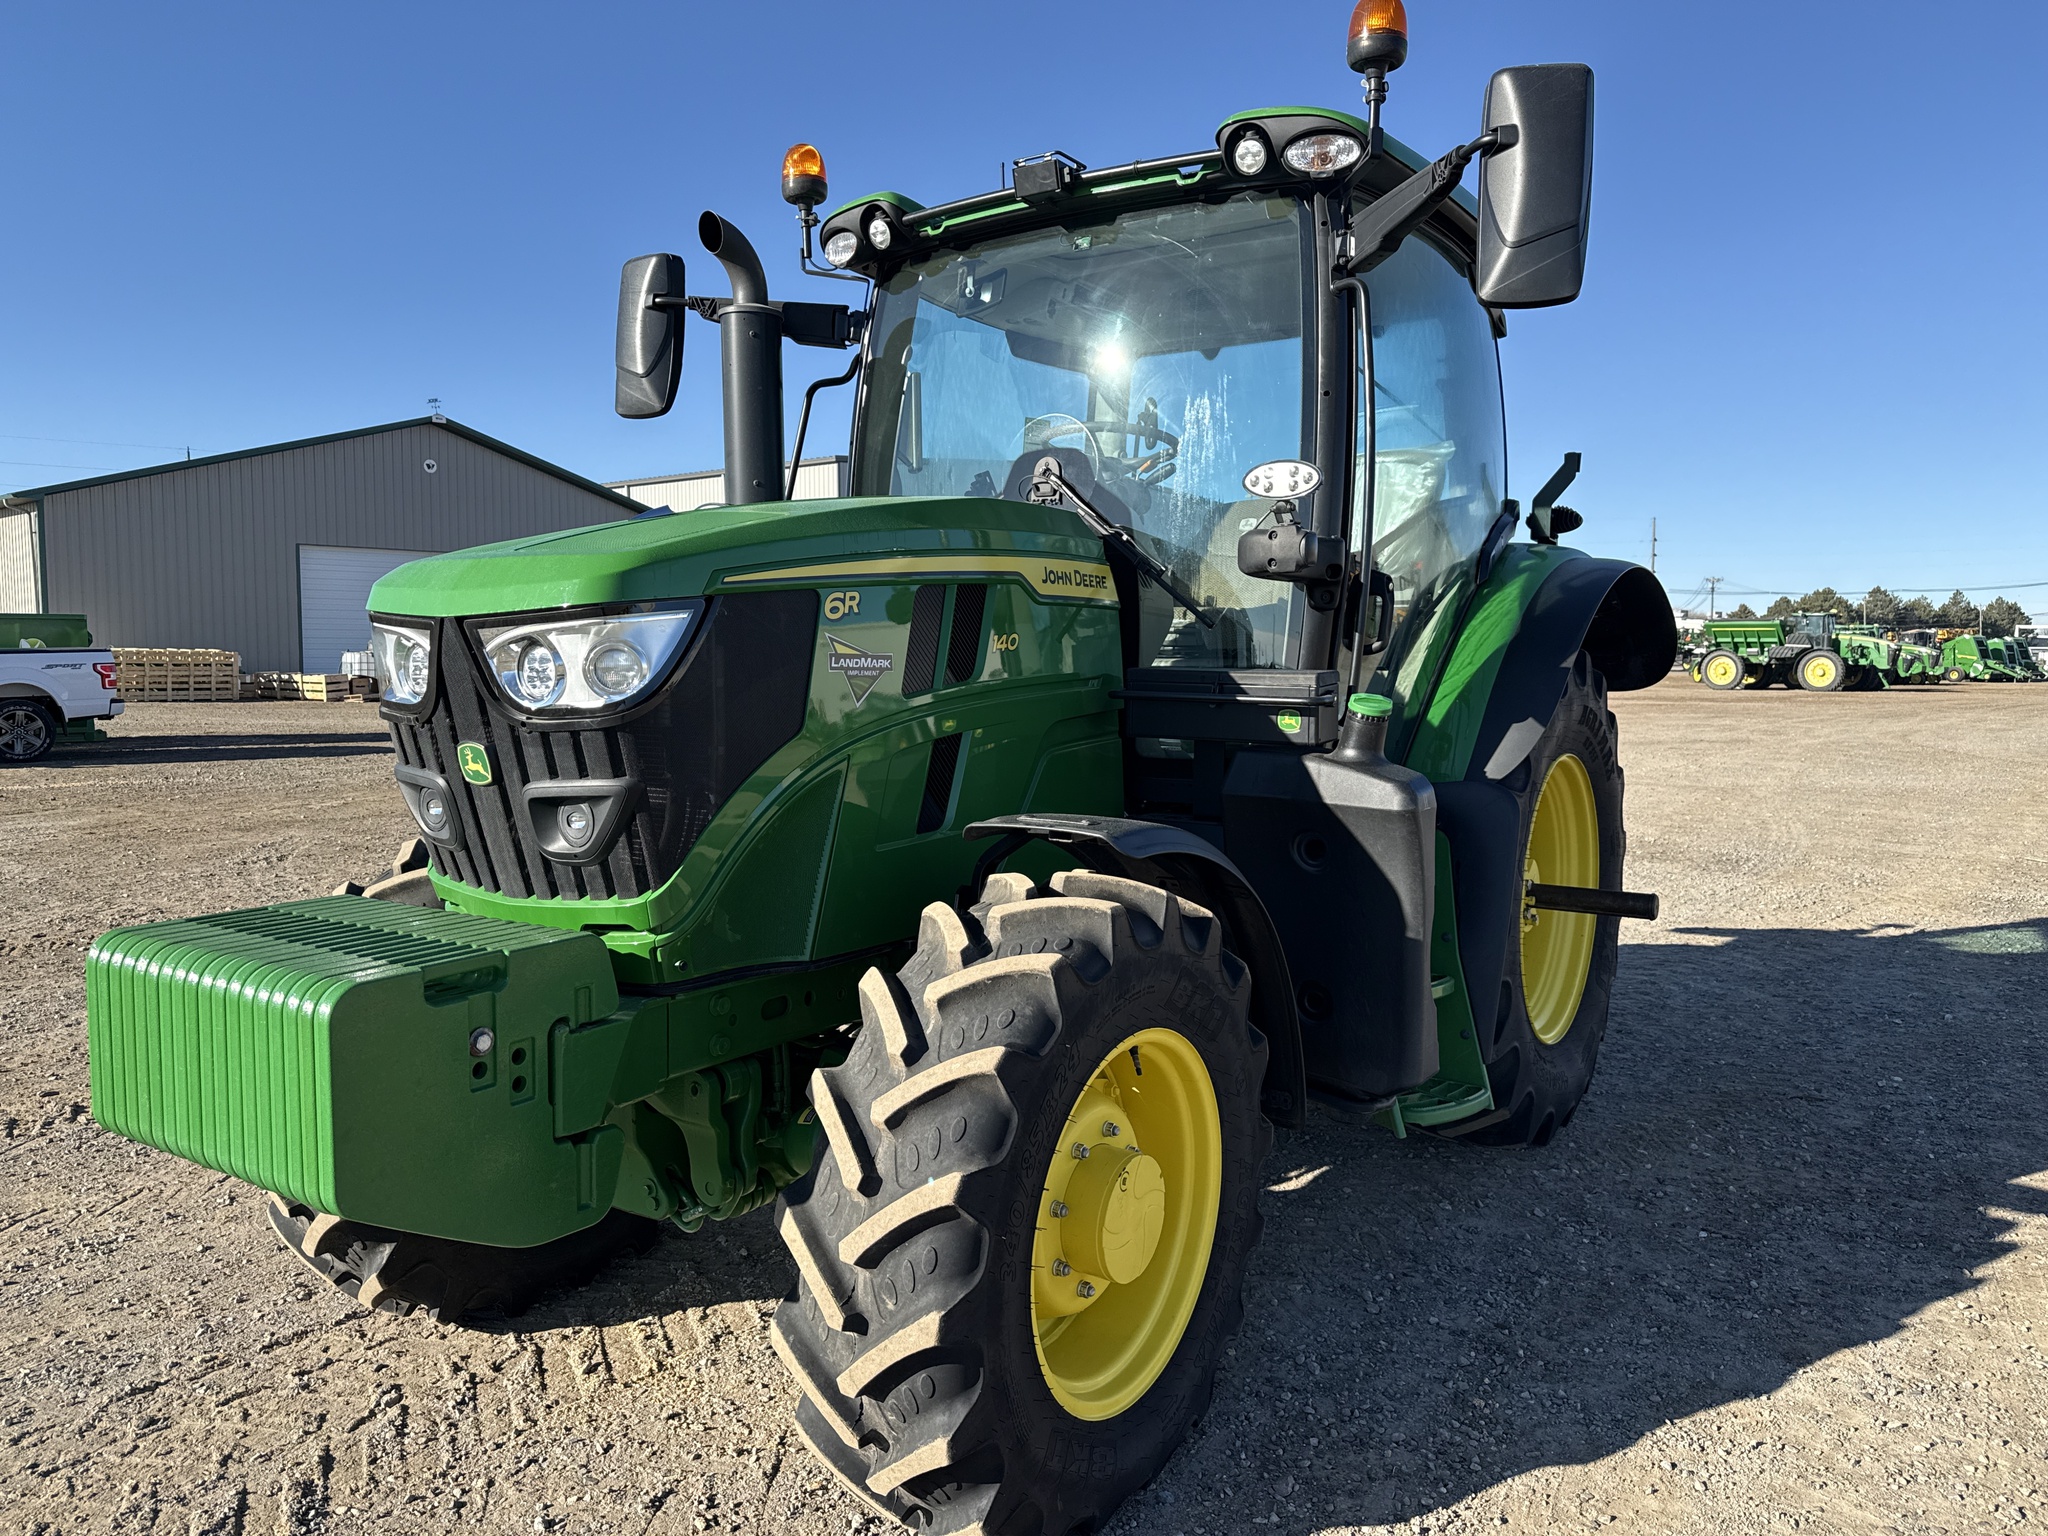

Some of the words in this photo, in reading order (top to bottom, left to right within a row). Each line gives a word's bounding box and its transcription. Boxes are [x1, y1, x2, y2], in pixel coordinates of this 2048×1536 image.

[1042, 566, 1073, 586] JOHN
[1073, 569, 1108, 589] DEERE
[824, 591, 861, 620] 6R
[992, 633, 1019, 653] 140
[41, 662, 87, 670] SPORT
